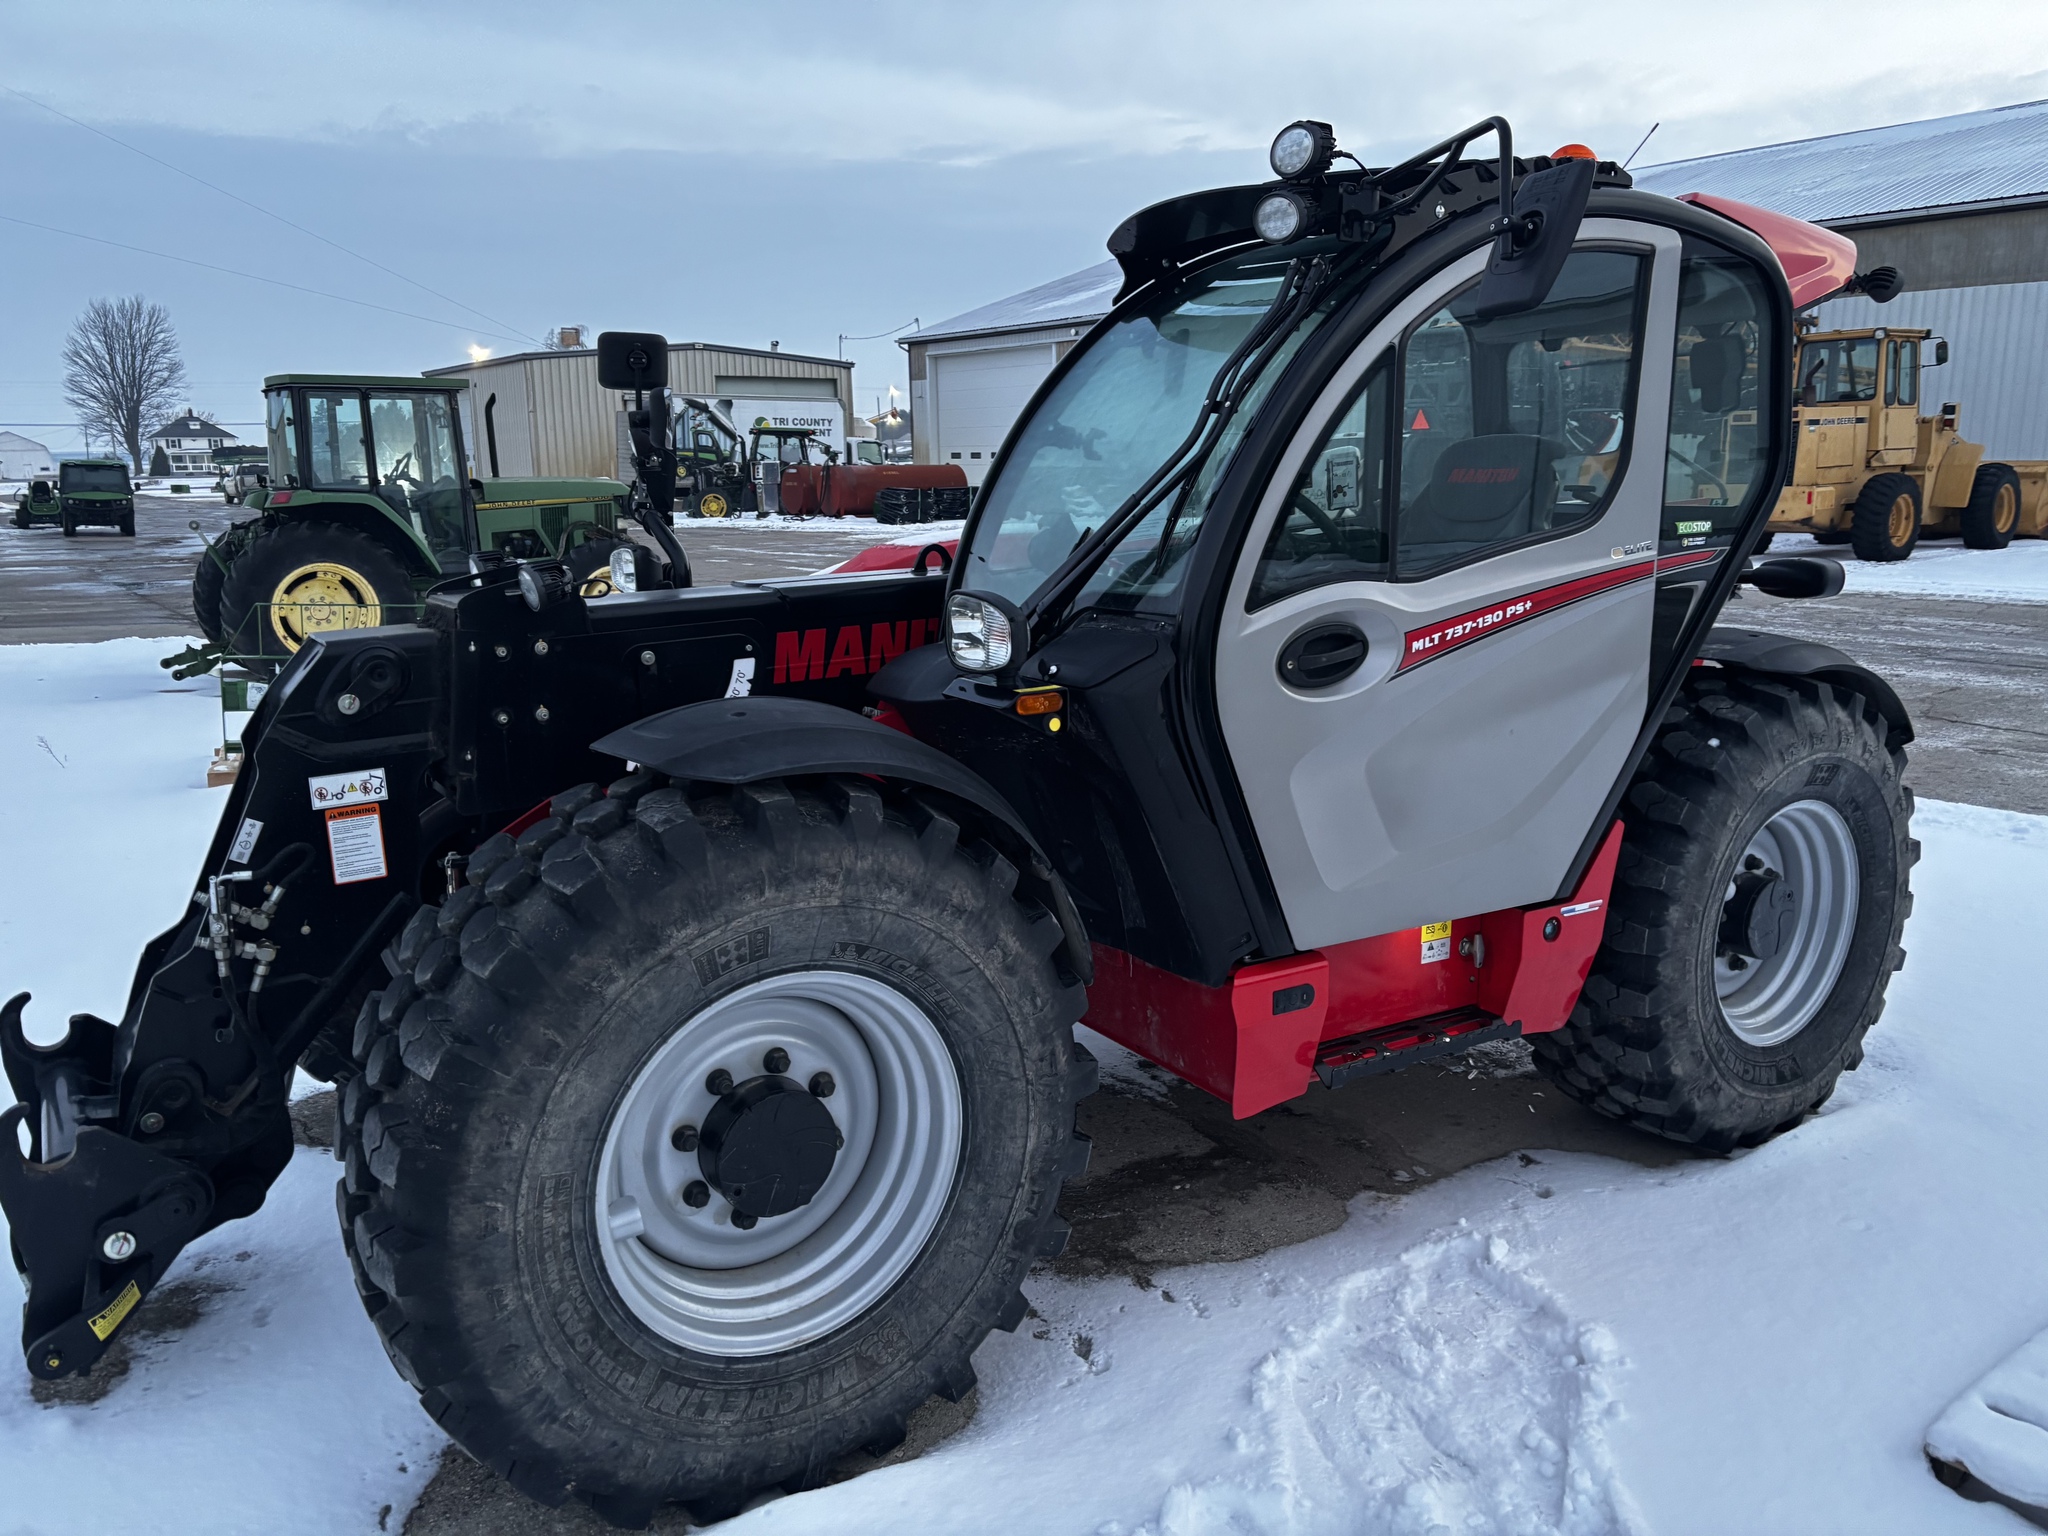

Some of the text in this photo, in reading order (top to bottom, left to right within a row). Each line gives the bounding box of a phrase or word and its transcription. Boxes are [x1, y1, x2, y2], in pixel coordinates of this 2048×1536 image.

[772, 417, 833, 427] TRI COUNTY
[1679, 521, 1711, 533] ECOSTOP
[1624, 541, 1653, 556] ELITE
[1411, 600, 1533, 654] MLT 737-130 PS+
[336, 806, 377, 818] WARNING
[753, 928, 765, 957] Line
[860, 947, 966, 1015] MICHELIN
[558, 1175, 572, 1204] IND
[647, 1353, 861, 1422] MICHELIN
